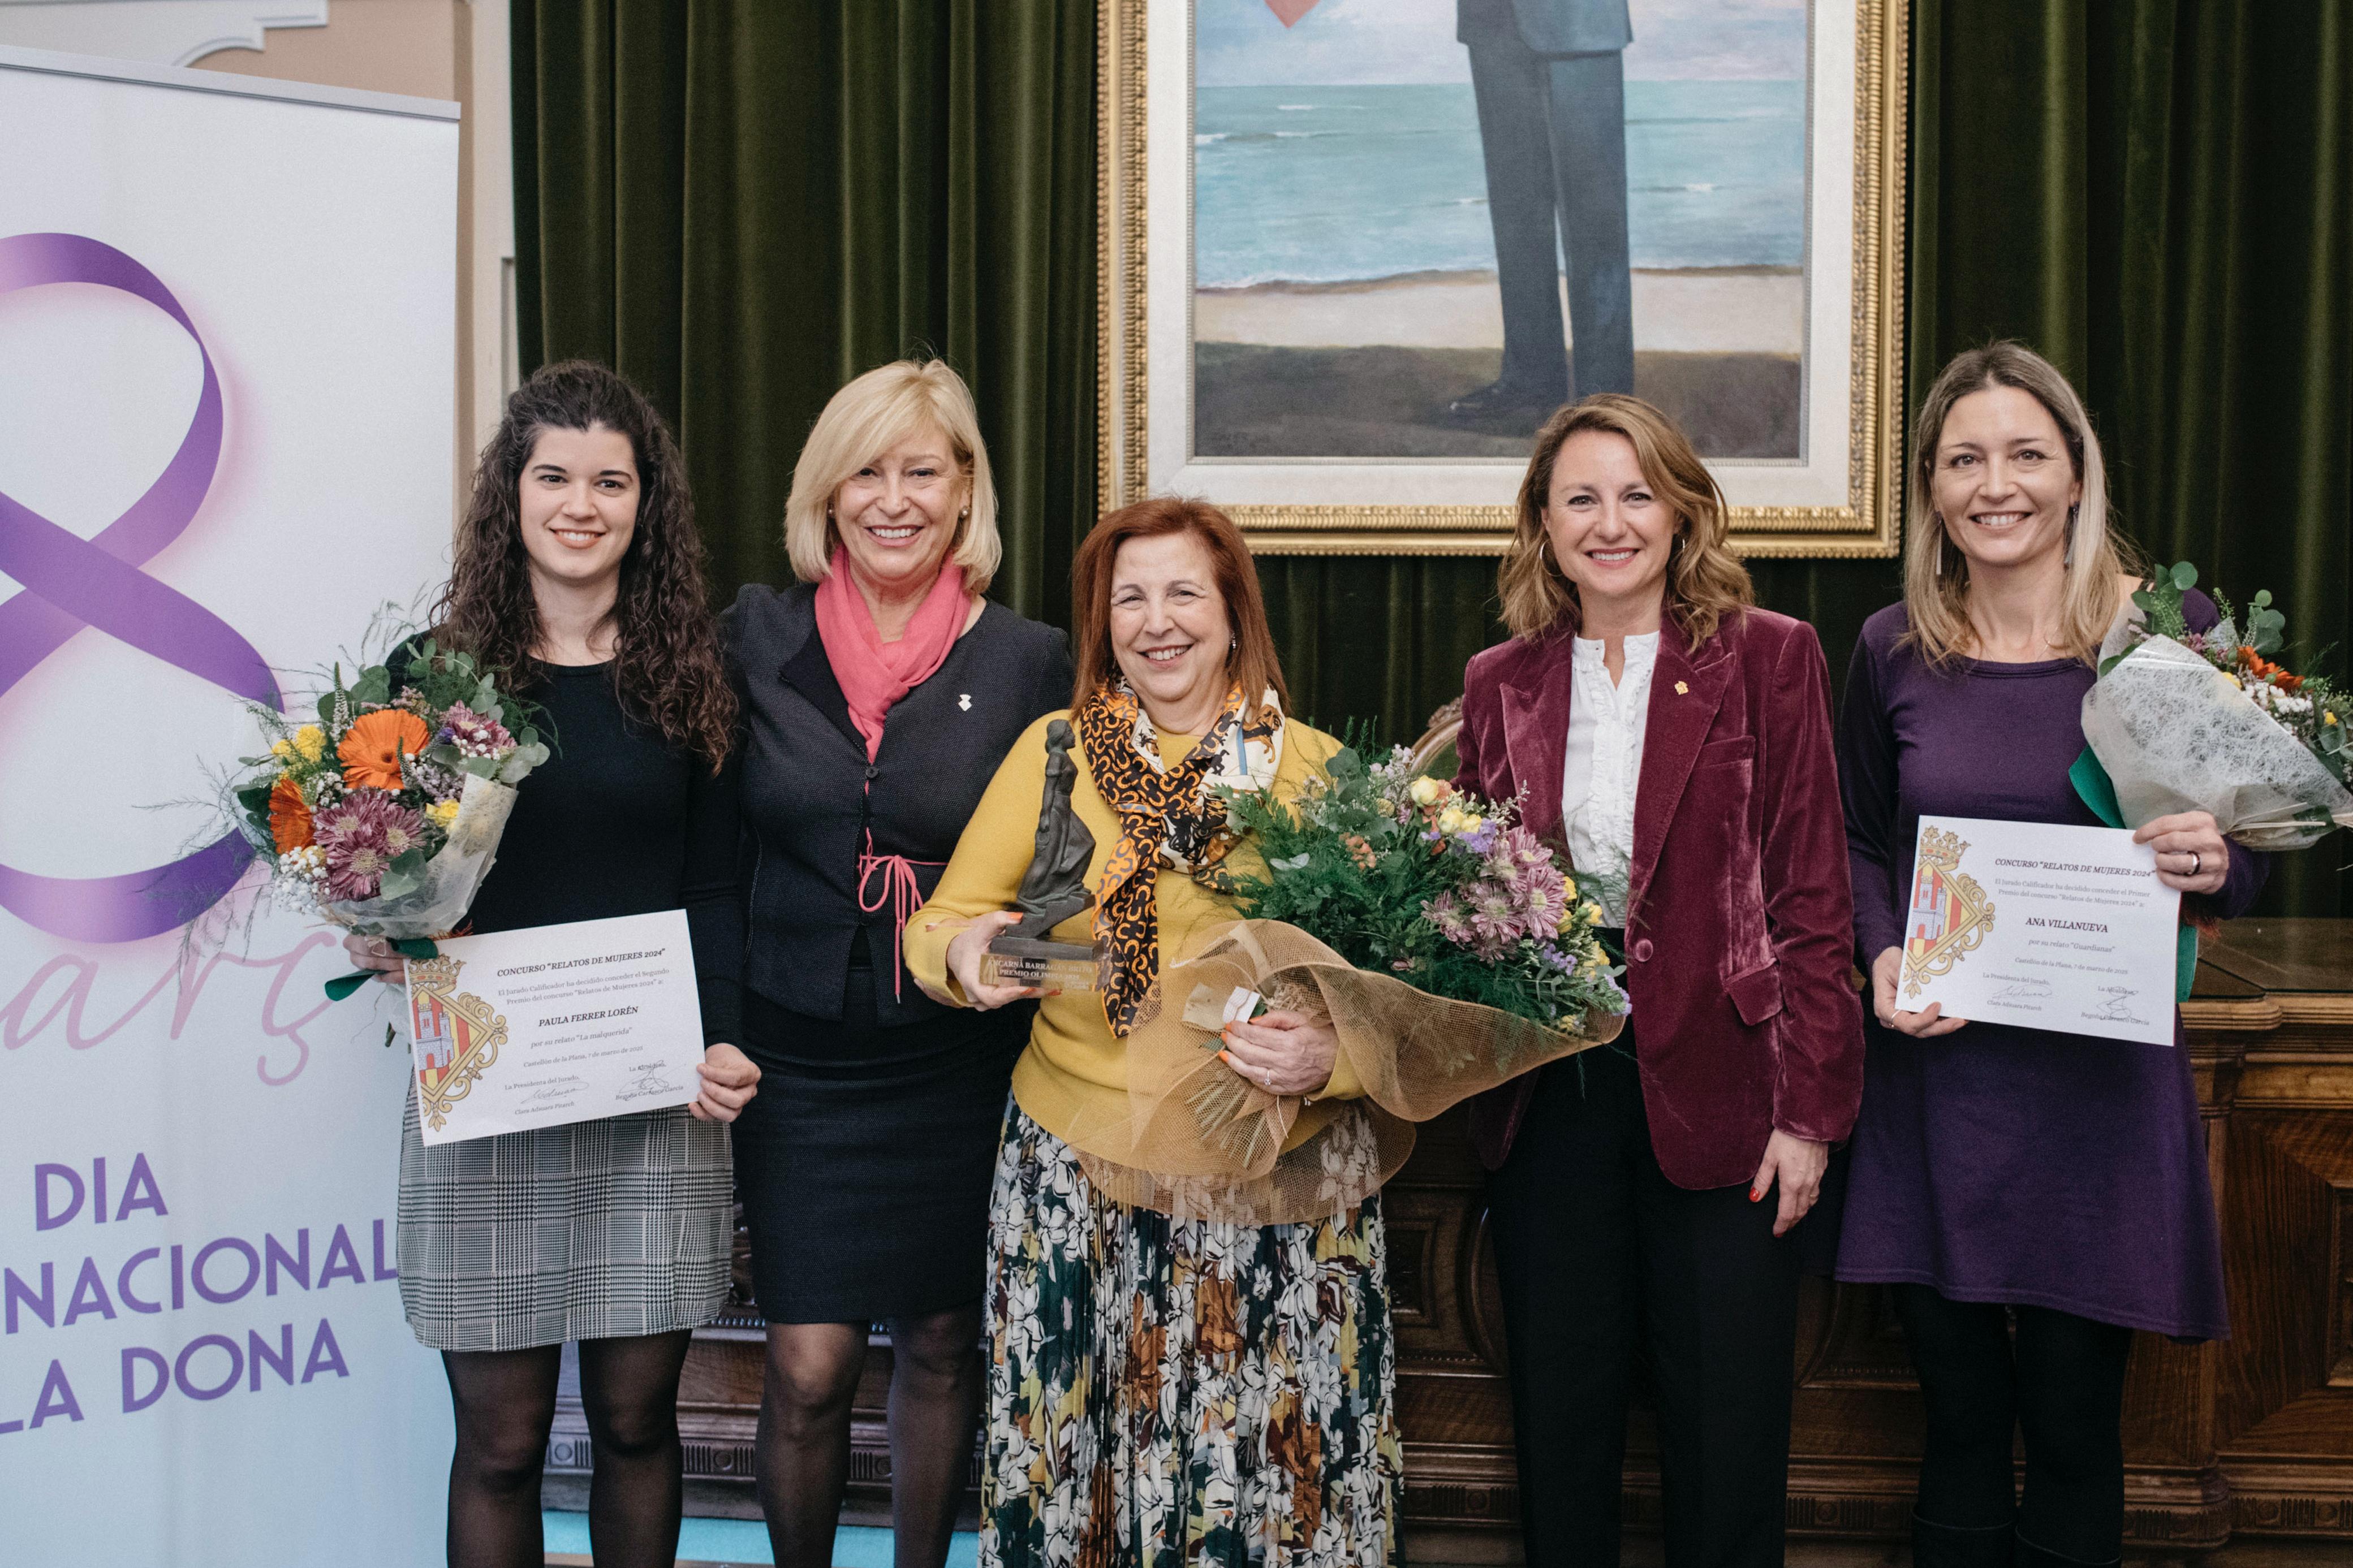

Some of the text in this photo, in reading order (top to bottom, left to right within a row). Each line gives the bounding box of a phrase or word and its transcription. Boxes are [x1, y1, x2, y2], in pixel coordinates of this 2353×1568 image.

[1995, 858, 2038, 869] CONCURSO
[2040, 861, 2078, 872] “RELATOS
[2093, 866, 2130, 877] MUJERES
[2132, 869, 2155, 878] 2024”
[2002, 879, 2020, 887] Jurado
[2022, 880, 2054, 889] Calificador
[2095, 897, 2119, 906] Mujeres
[2026, 917, 2108, 932] ANA VILLANUEVA
[2071, 942, 2114, 953] “Guardianas”
[497, 964, 545, 977] CONCURSO
[547, 958, 589, 970] “RELATOS
[606, 951, 643, 964] MUJERES
[644, 948, 665, 958] 2024”
[506, 986, 528, 995] Jurado
[529, 982, 565, 992] Calificador
[576, 977, 603, 986] decidido
[605, 973, 633, 982] conceder
[642, 968, 669, 978] Segundo
[999, 969, 1029, 978] PREMIO
[1990, 973, 2019, 982] Presidenta
[544, 991, 573, 1000] concurso
[575, 986, 601, 995] “Relatos
[612, 982, 637, 991] Mujeres
[539, 1005, 638, 1026] PAULA FERRER LORÉN
[531, 1040, 543, 1049] por
[554, 1035, 575, 1044] relato
[590, 1027, 632, 1040] malquerida”
[514, 1079, 546, 1088] Presidenta
[35, 1152, 169, 1232] DIA
[4, 1219, 398, 1334] NACIONAL
[120, 1318, 350, 1414] DONA
